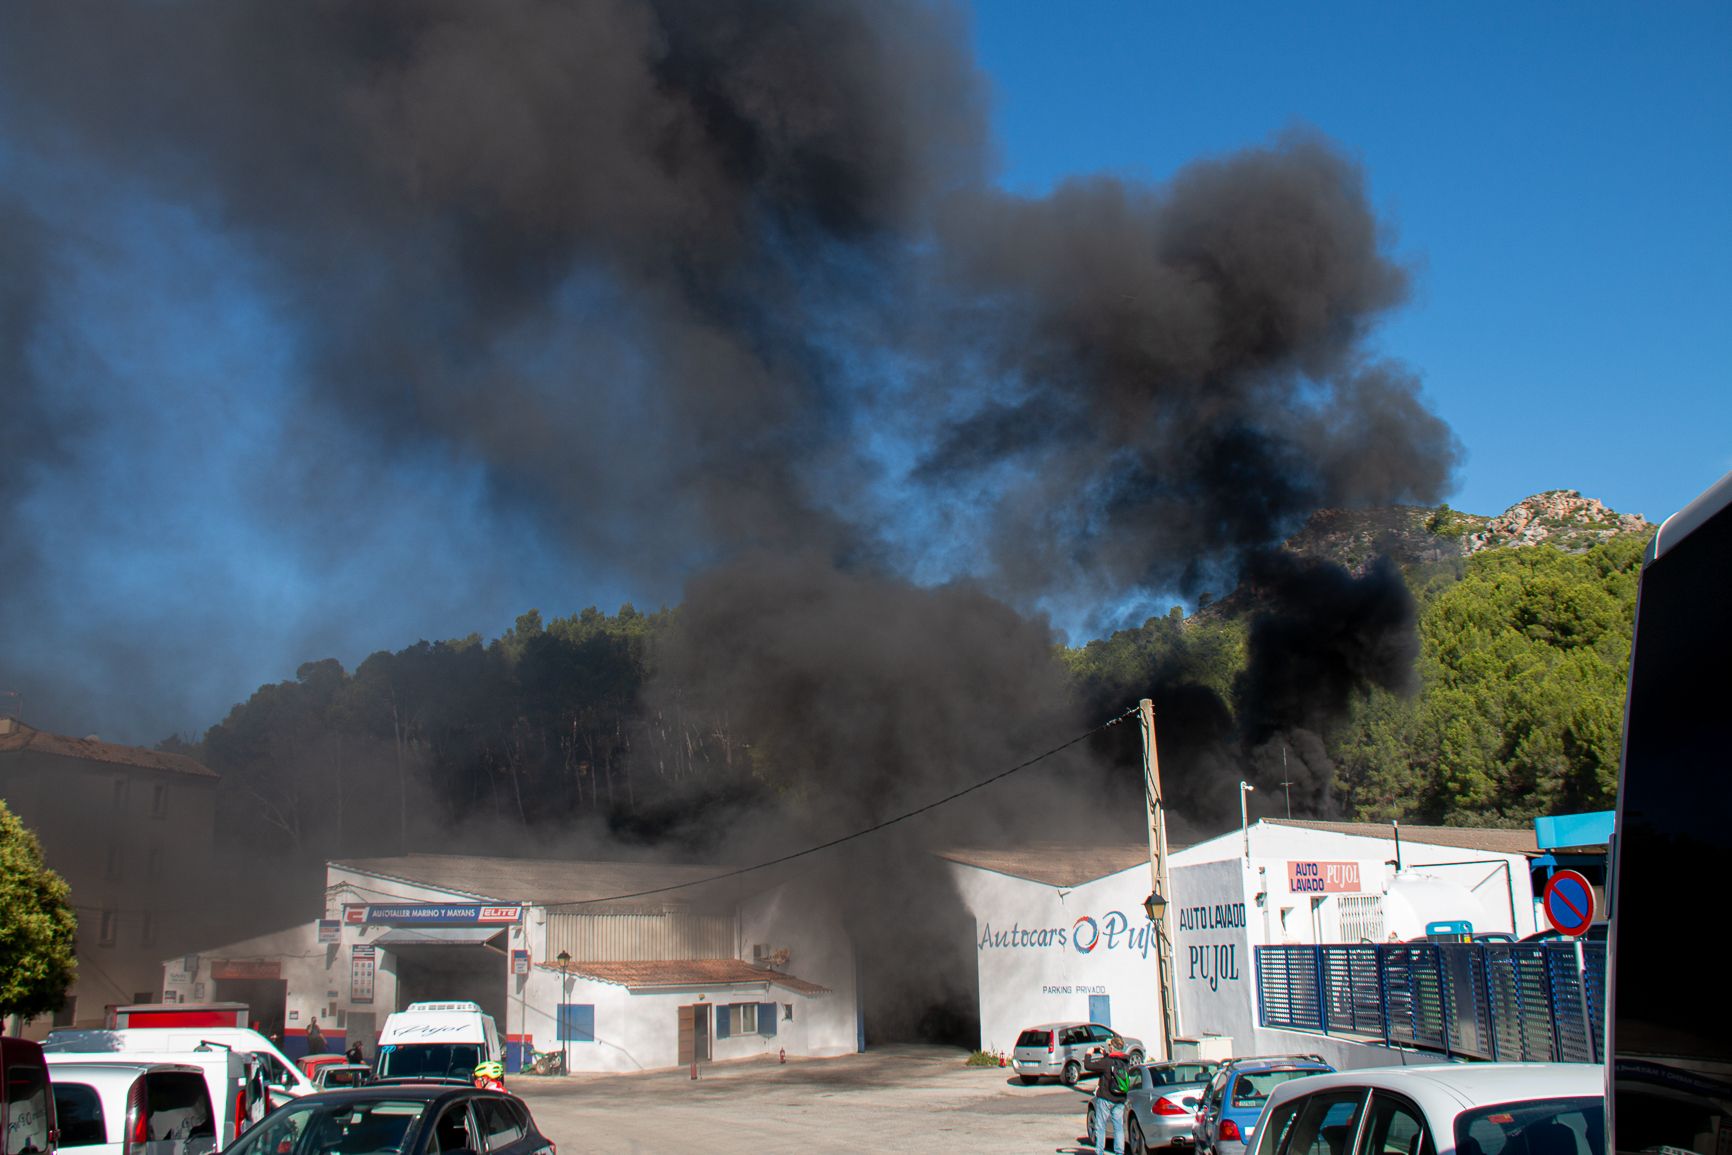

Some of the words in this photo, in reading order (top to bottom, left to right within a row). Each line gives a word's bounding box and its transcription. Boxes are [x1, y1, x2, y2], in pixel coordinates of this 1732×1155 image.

[1296, 863, 1318, 876] AUTO
[1326, 864, 1359, 888] PUJOL
[1291, 879, 1324, 891] LAVADO
[372, 909, 410, 918] AUTOTALLER
[412, 909, 439, 917] MARINO
[440, 909, 446, 917] Y
[447, 909, 475, 917] MAYANS
[978, 922, 1067, 950] Autocars
[1102, 911, 1156, 959] Puj
[1188, 944, 1238, 992] PUJOL
[1043, 986, 1072, 994] PARKING
[1076, 986, 1106, 994] PRIVADO
[393, 1024, 470, 1037] Pujol
